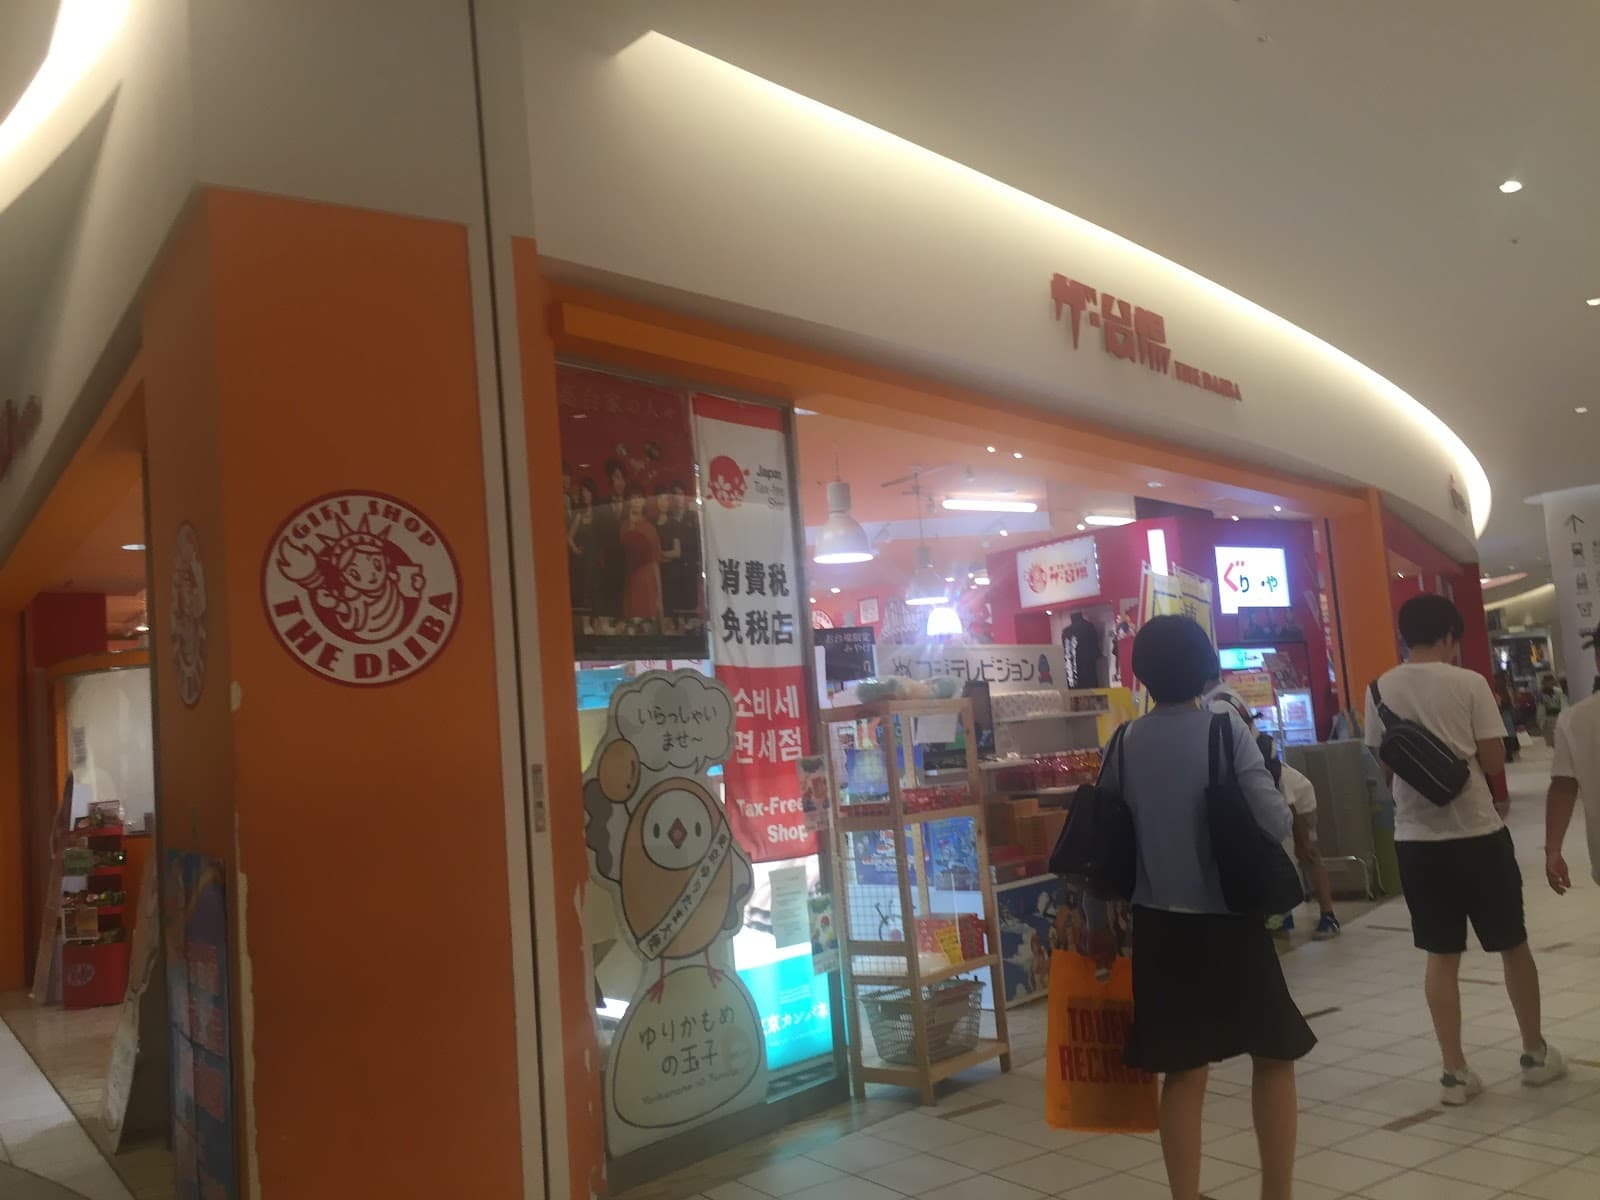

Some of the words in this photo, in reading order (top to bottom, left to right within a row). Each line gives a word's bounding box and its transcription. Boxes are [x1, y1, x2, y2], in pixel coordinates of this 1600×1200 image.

[292, 500, 350, 540] GIFT
[367, 500, 437, 547] SHOP
[718, 559, 790, 597] 消費税
[273, 594, 344, 673] THE
[353, 592, 454, 680] DAIBA
[721, 607, 793, 645] 免税店
[638, 706, 717, 725] いらっしゃい
[733, 685, 799, 721] 소비세
[735, 727, 802, 764] 면세점
[767, 824, 809, 843] Shop
[639, 1005, 736, 1051] ゆりかもめ
[661, 1040, 719, 1077] の玉子
